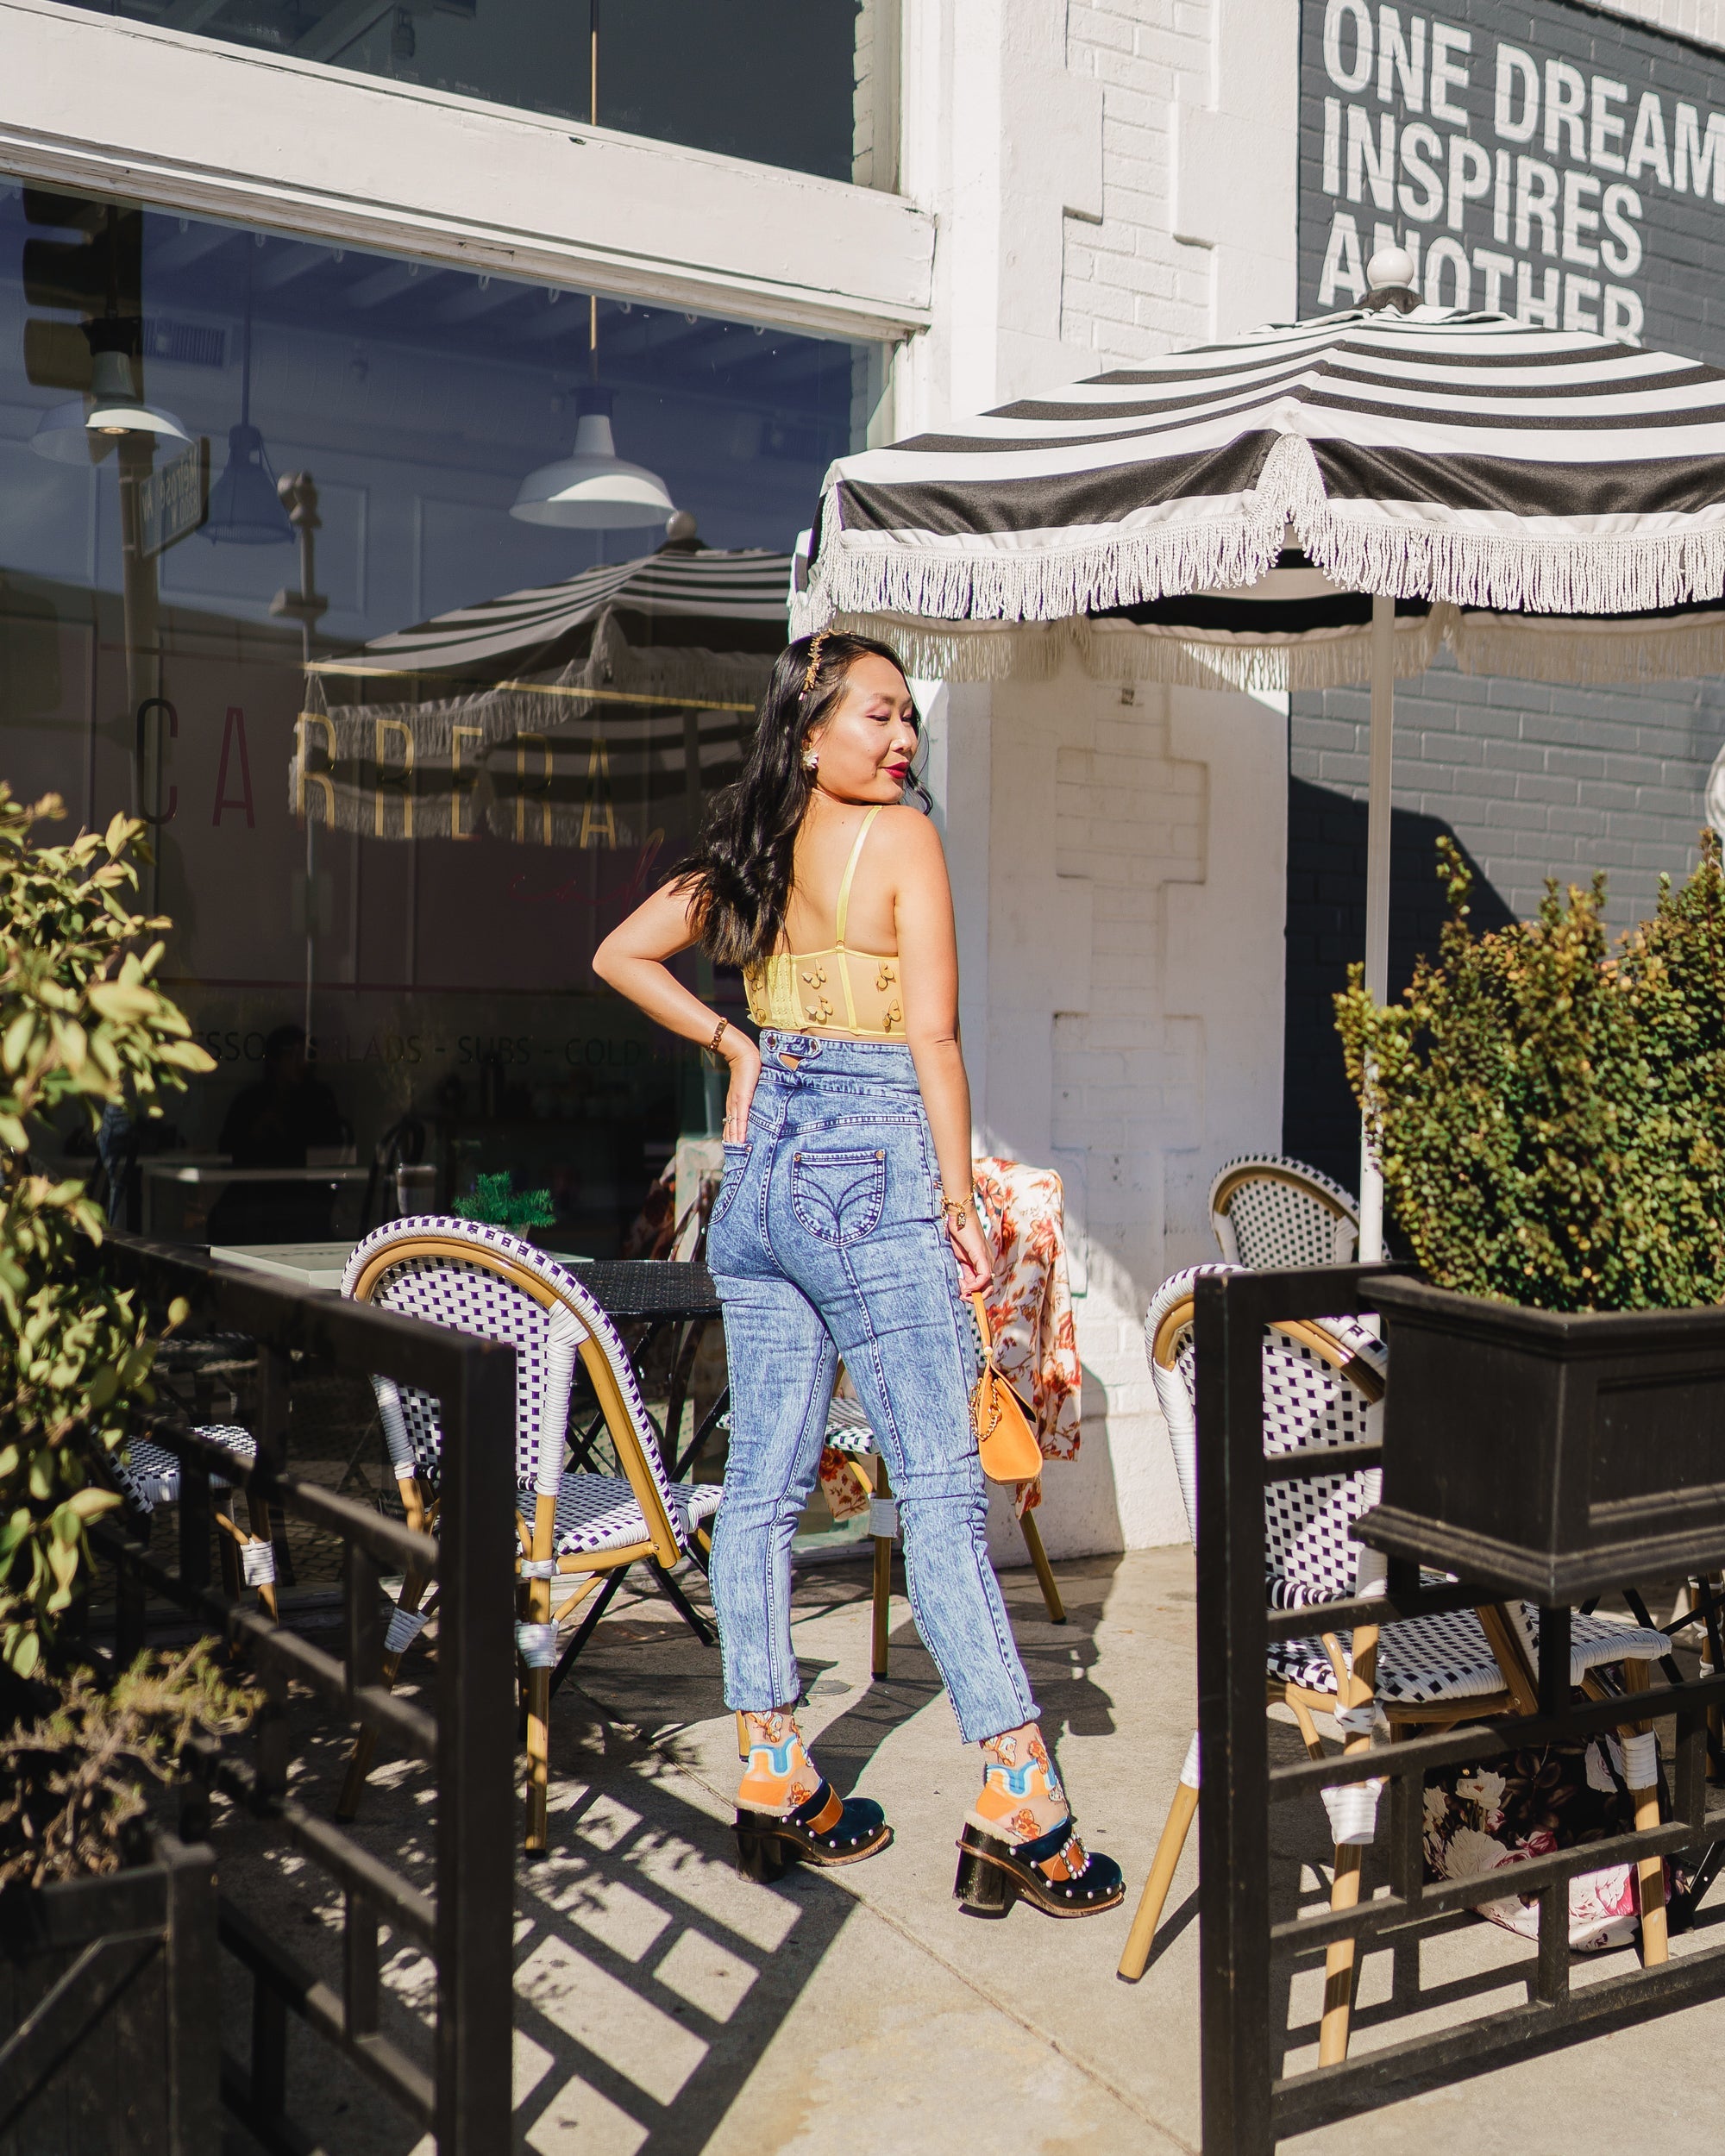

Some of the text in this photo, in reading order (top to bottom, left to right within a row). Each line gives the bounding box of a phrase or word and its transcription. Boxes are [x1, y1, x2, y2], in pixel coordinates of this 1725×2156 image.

[1322, 0, 1725, 204] ONE DREAM
[1322, 95, 1642, 278] INSPIRES
[135, 697, 618, 850] CARRERA
[457, 1035, 530, 1065] SUBS
[565, 1037, 641, 1068] COLD
